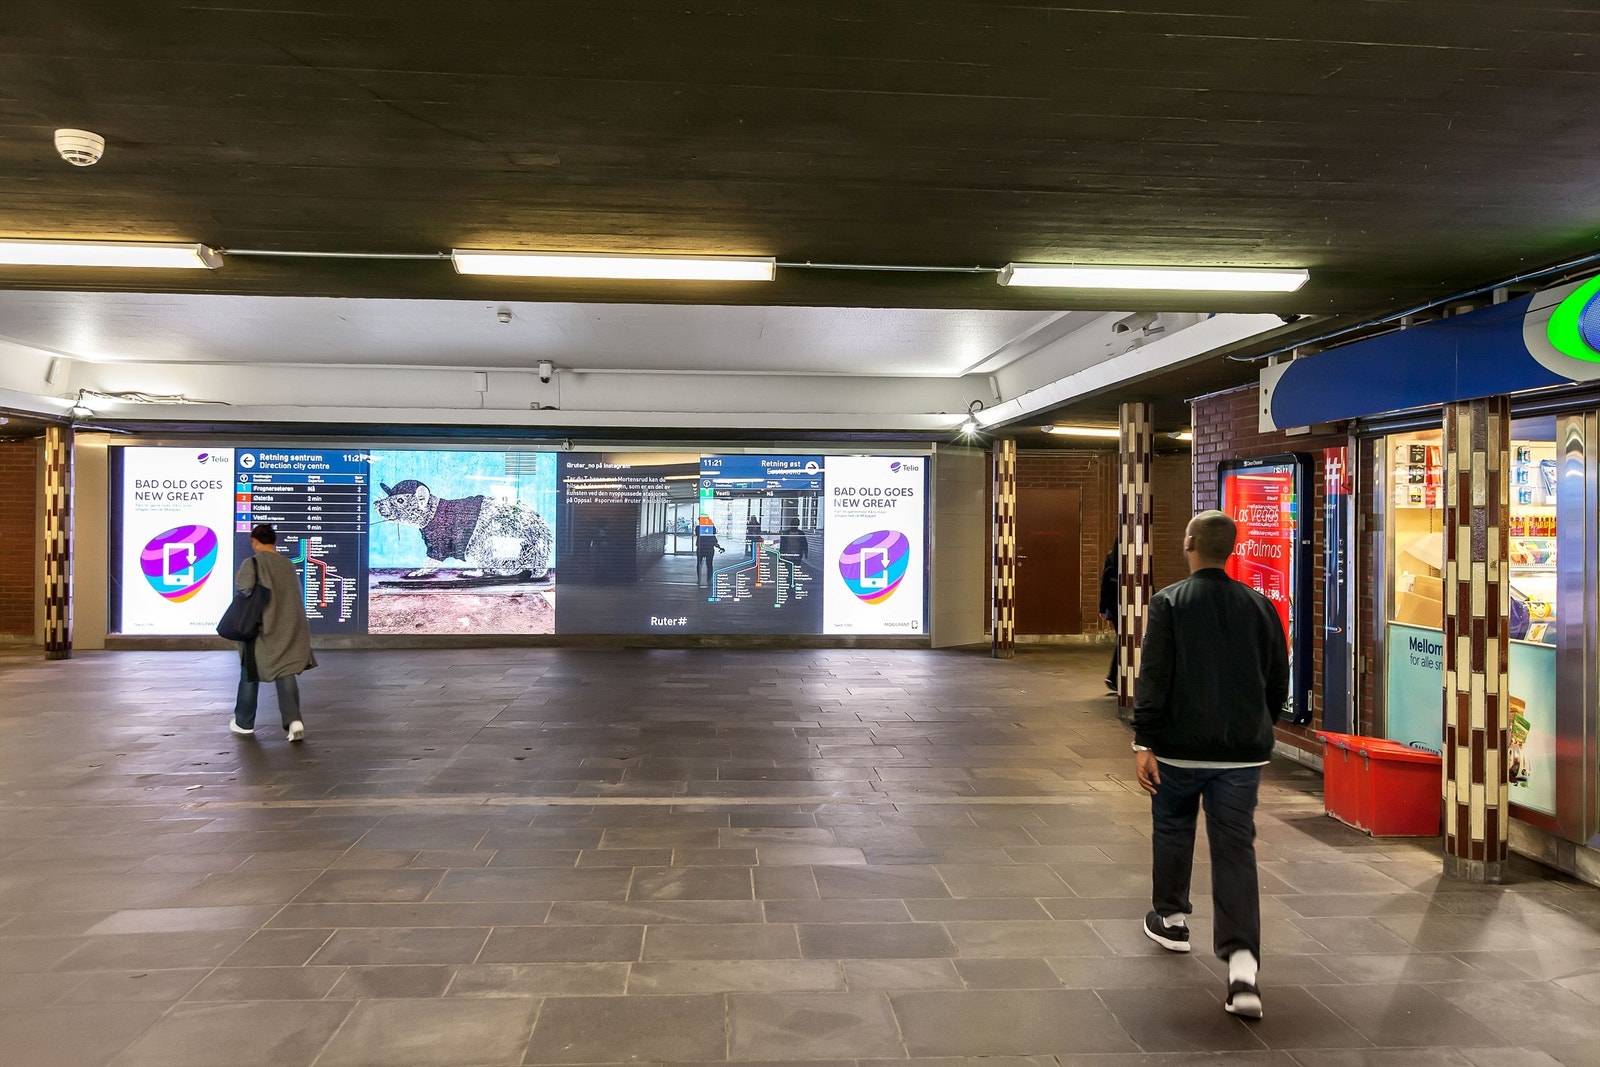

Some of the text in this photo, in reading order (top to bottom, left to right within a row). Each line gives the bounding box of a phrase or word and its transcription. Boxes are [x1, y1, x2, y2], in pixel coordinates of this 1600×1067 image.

[260, 454, 288, 462] Retning
[762, 460, 788, 468] Retning
[136, 480, 222, 489] BAD OLD GOES
[834, 487, 914, 496] BAD OLD GOES
[135, 492, 204, 501] NEW GREAT
[834, 499, 897, 508] NEW GREAT
[1234, 506, 1249, 522] Las
[1247, 539, 1282, 558] Palmas
[651, 616, 688, 626] Ruter#
[1410, 653, 1420, 666] for
[1421, 656, 1434, 669] alle
